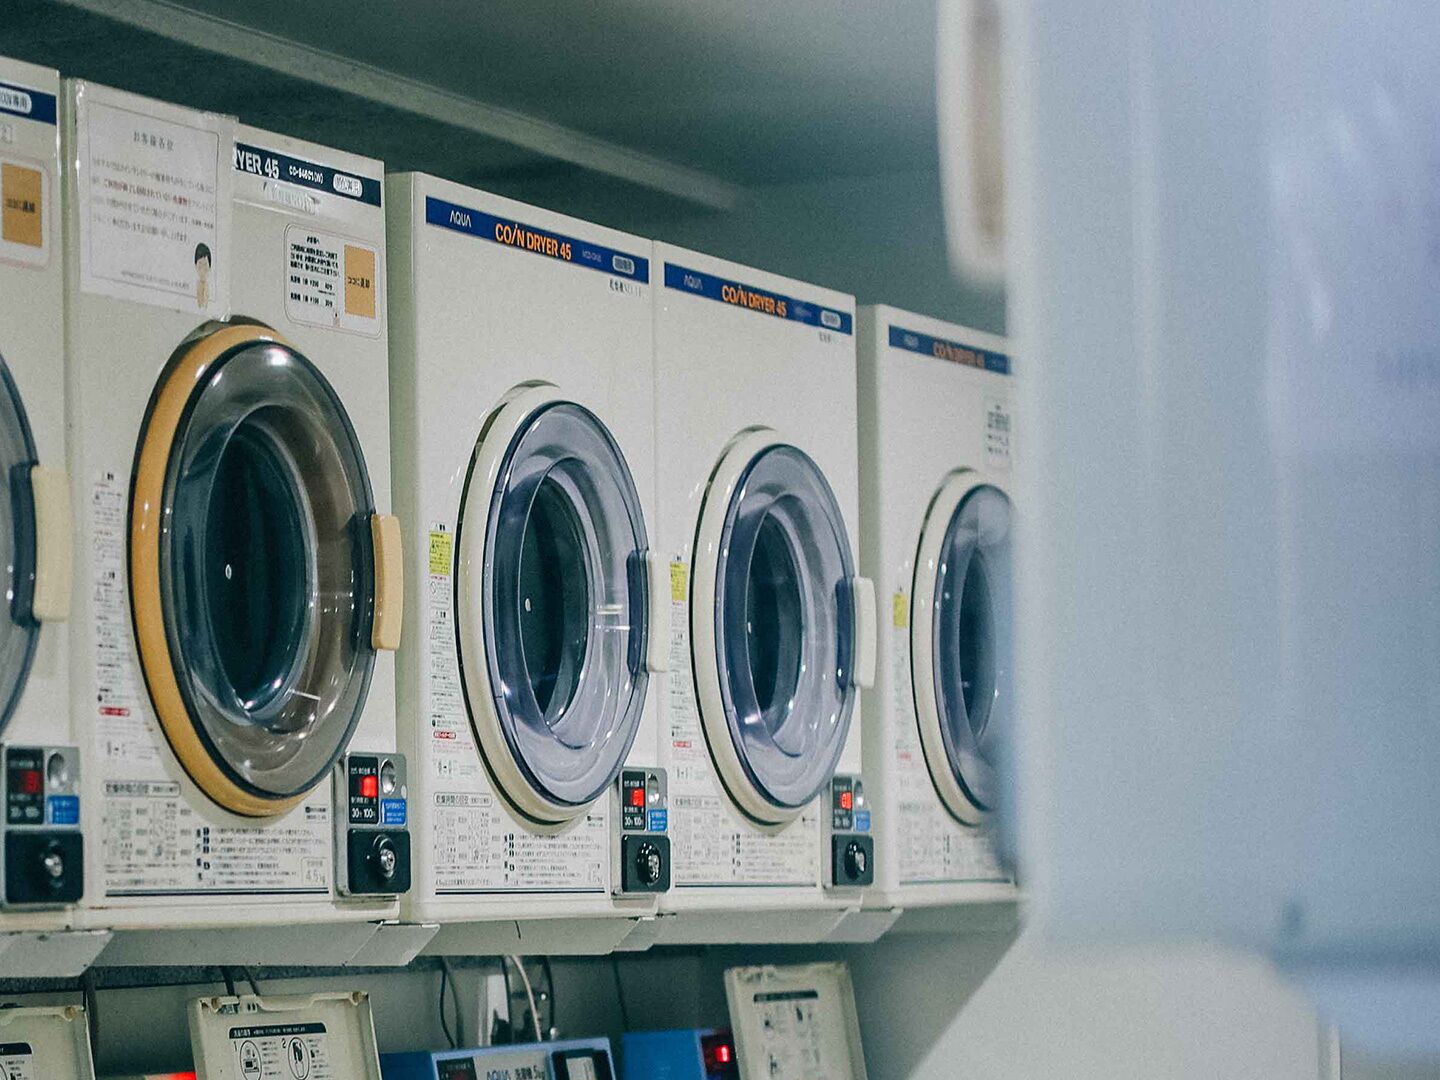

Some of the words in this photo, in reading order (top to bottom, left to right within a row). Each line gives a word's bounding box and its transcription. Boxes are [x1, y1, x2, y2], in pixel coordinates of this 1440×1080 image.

[264, 157, 280, 179] 45
[449, 209, 472, 228] AQUA
[526, 231, 559, 257] DRYER
[559, 242, 572, 261] 45
[748, 292, 776, 315] DRYER
